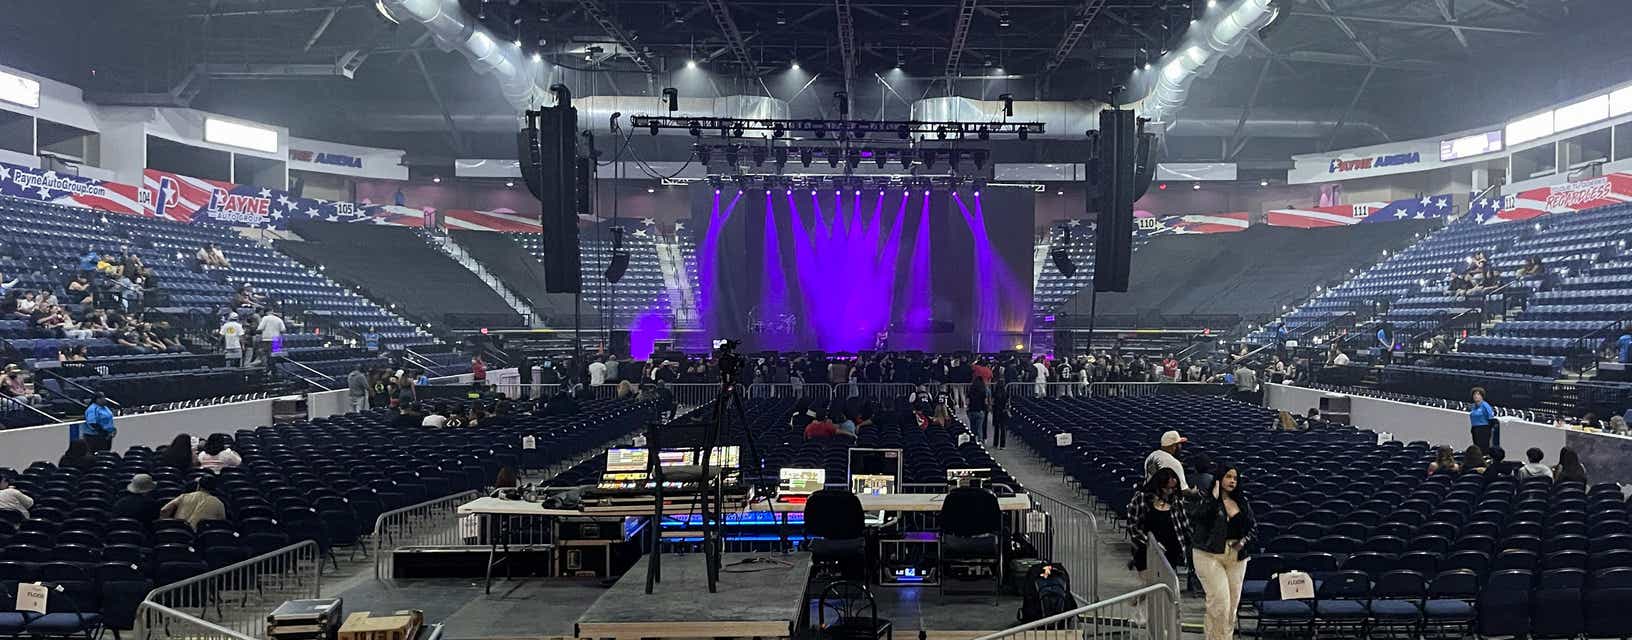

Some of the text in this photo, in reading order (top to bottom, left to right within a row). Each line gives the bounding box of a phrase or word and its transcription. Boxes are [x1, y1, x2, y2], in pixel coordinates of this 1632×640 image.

[1374, 151, 1421, 167] ARENA
[14, 170, 106, 196] PayneAutoGroup.com
[139, 191, 151, 205] 104
[209, 187, 271, 216] PAYNE
[1545, 182, 1612, 209] REGARDLESS
[338, 203, 354, 215] 105
[1354, 205, 1368, 217] 111
[218, 212, 263, 223] AUTO GROUP
[1140, 218, 1154, 228] 110
